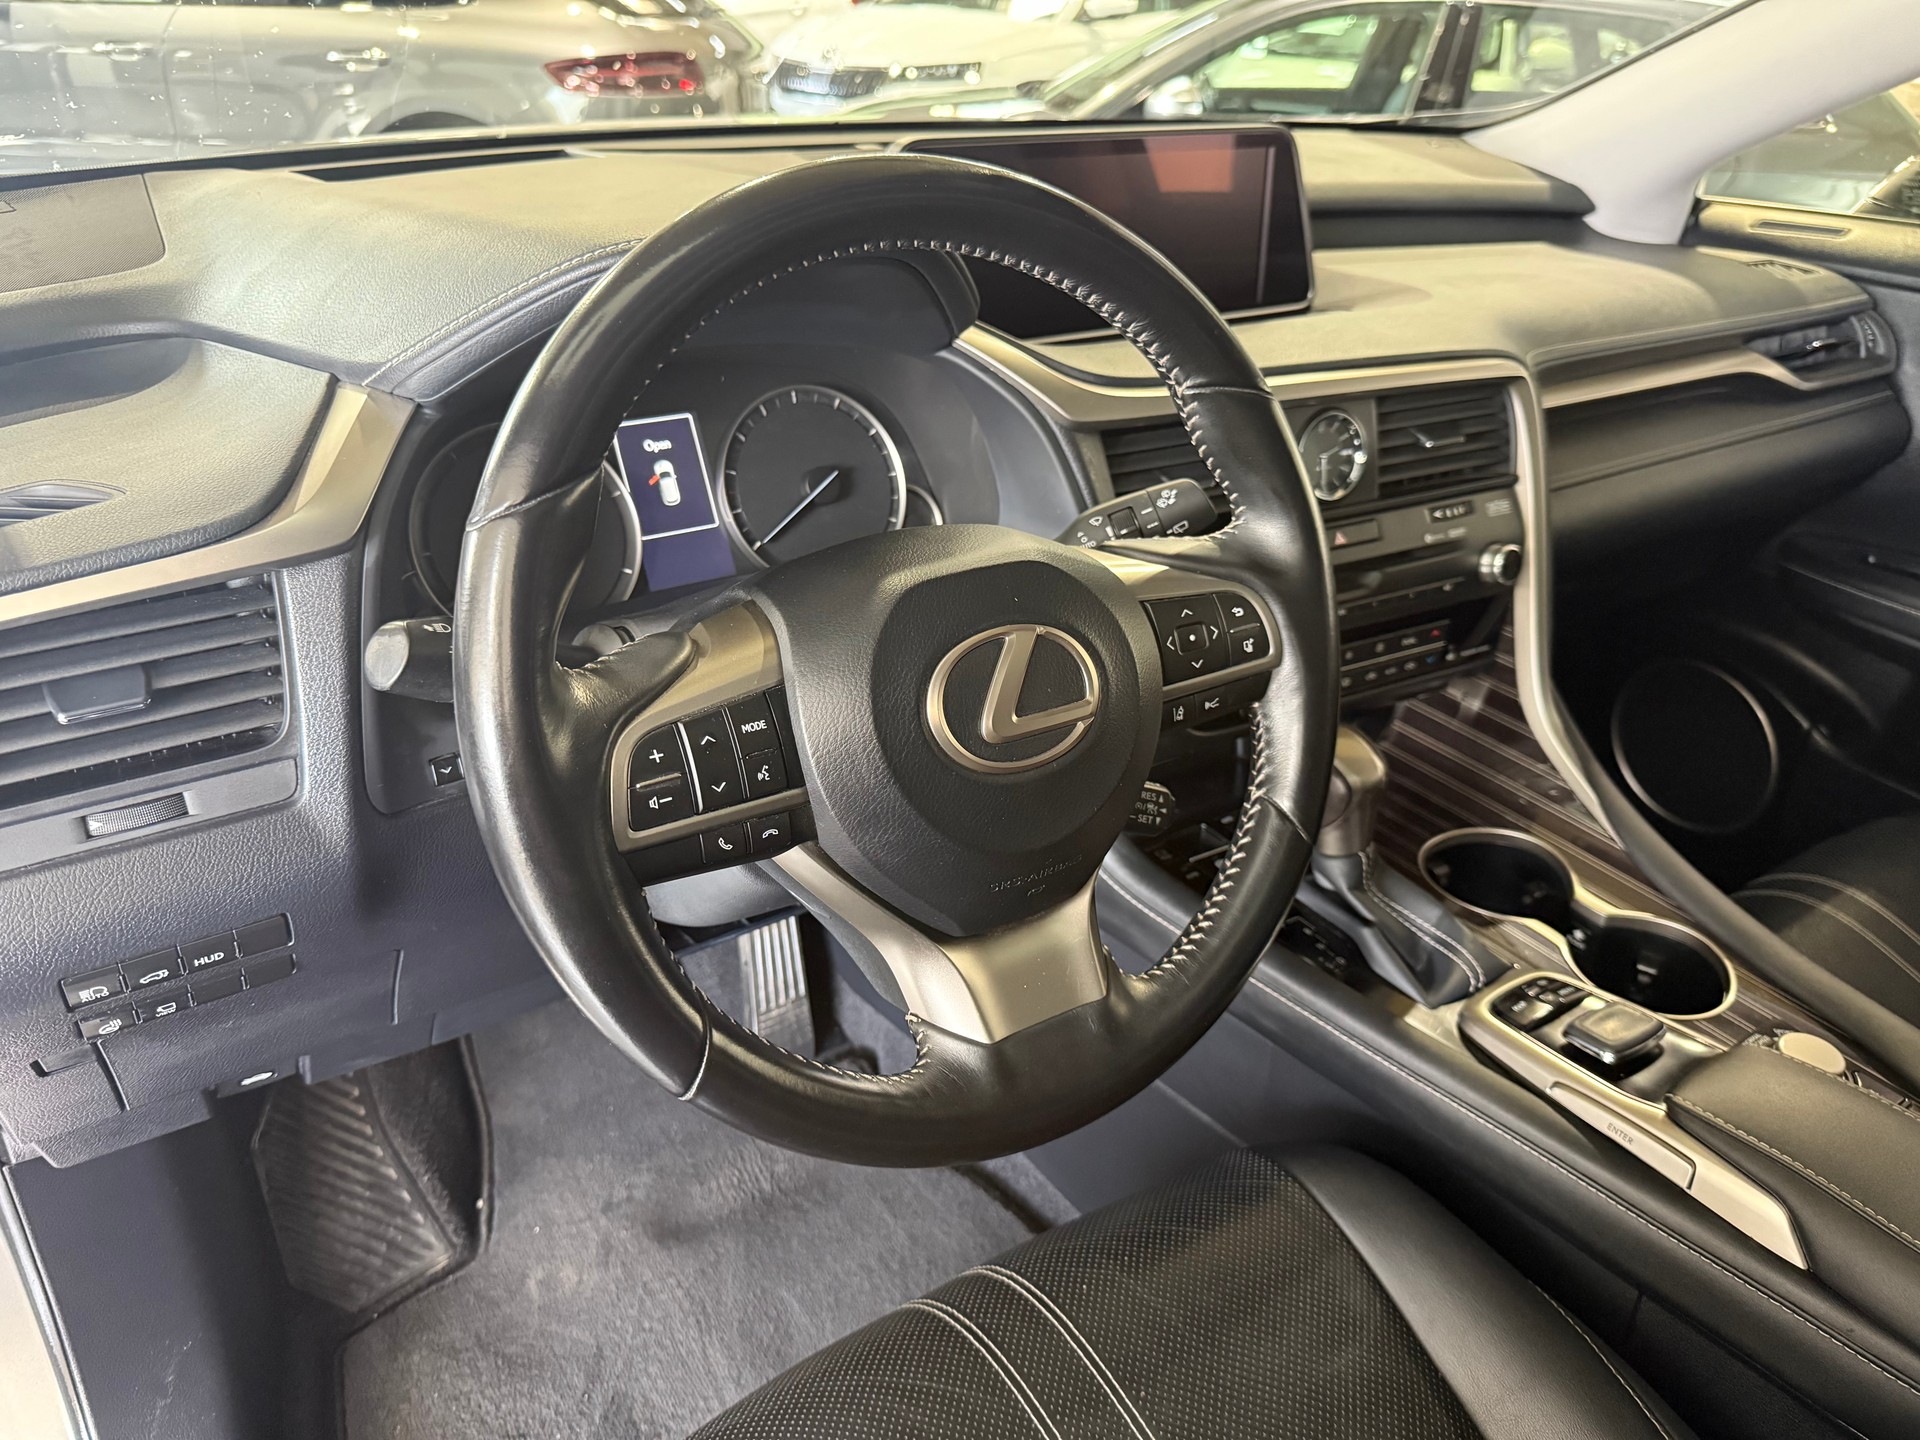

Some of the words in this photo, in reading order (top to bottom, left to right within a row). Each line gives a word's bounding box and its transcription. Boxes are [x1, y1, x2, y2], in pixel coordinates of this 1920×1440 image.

[643, 439, 672, 453] Open
[741, 719, 768, 734] MODE
[1140, 790, 1157, 801] RES
[1137, 814, 1153, 824] SET
[193, 951, 225, 967] HUD
[81, 990, 110, 1003] AUTO
[155, 1008, 177, 1018] VIEW
[1606, 1122, 1634, 1145] ENTER
